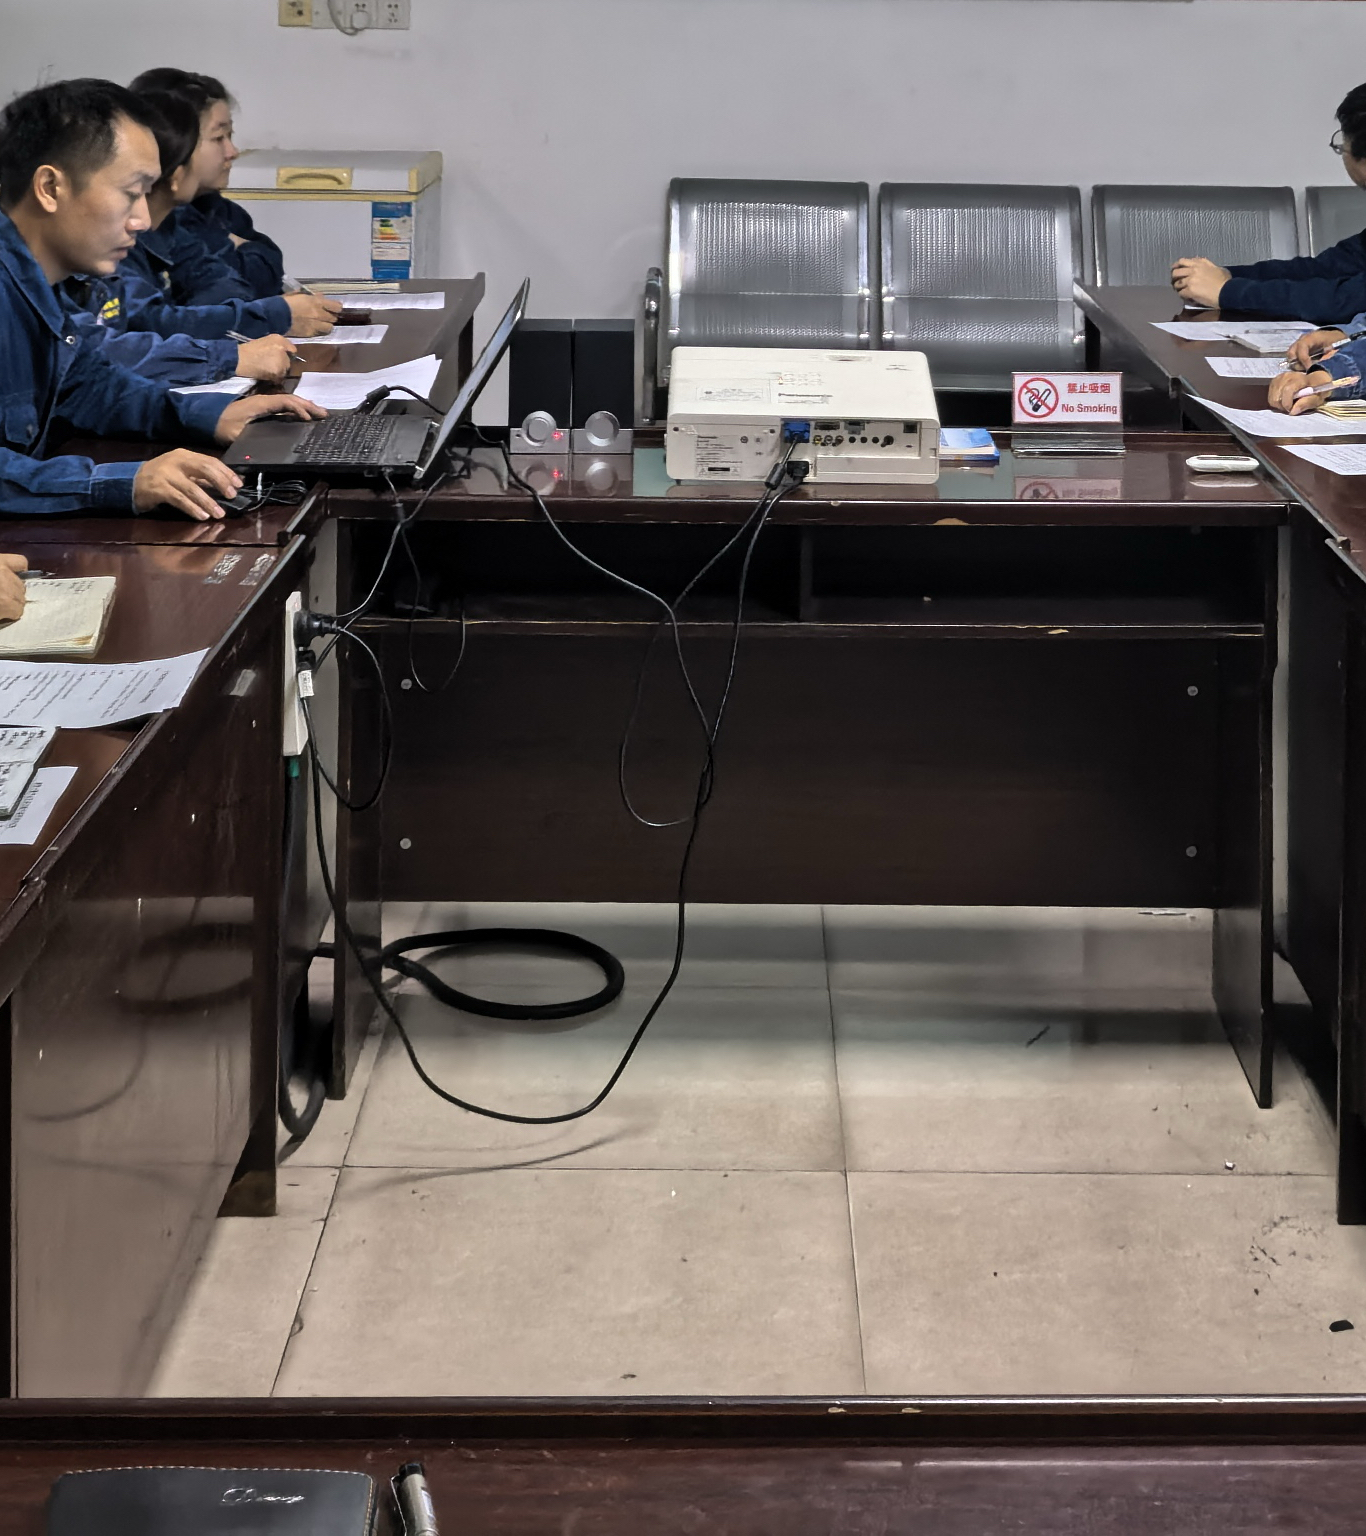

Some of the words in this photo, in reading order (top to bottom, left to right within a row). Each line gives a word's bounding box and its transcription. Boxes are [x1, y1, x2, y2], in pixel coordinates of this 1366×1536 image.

[1067, 383, 1111, 394] 禁止吸烟
[1061, 404, 1075, 413] No
[1077, 403, 1118, 414] Smoking
